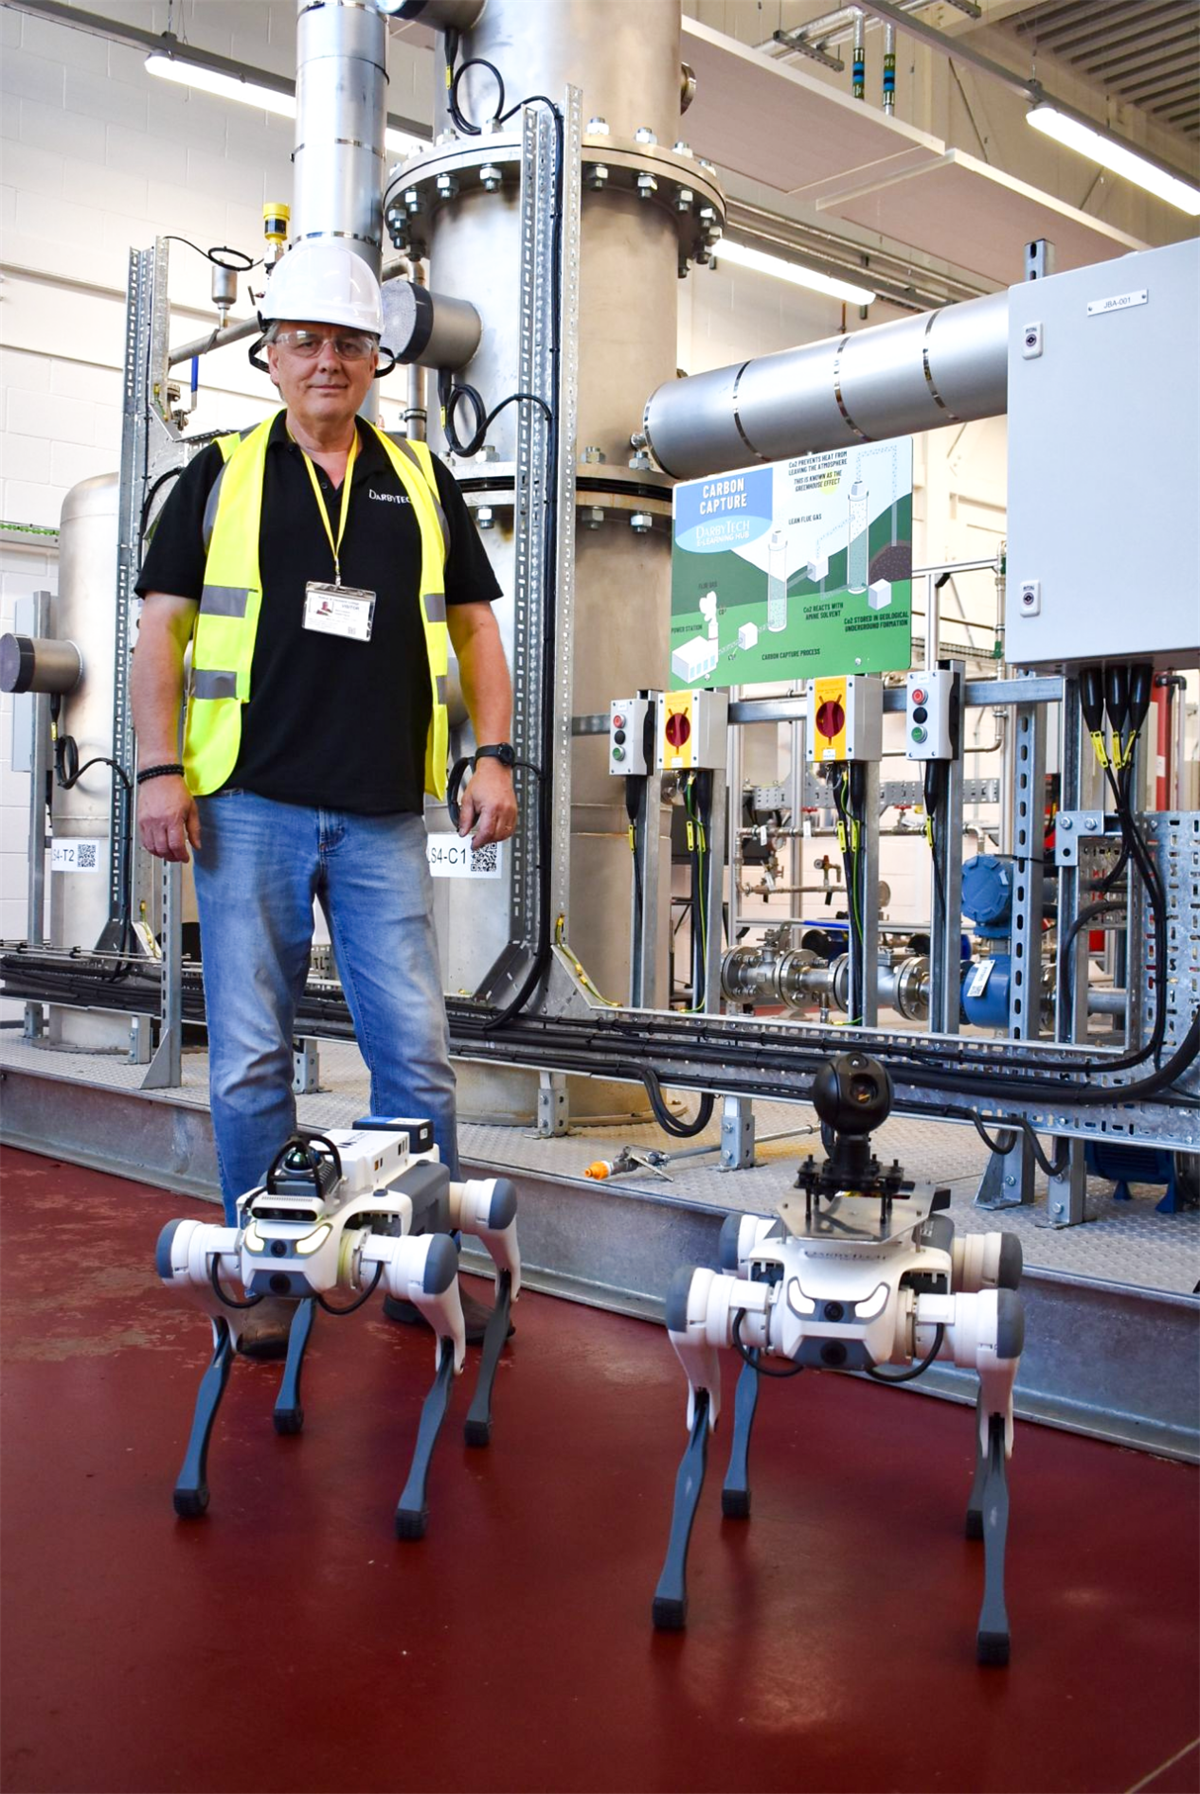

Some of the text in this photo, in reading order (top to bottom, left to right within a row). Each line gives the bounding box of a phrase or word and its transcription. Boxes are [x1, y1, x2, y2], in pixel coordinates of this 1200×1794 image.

[1103, 296, 1131, 309] JBA-001
[798, 456, 821, 466] PREVENTS
[822, 453, 834, 462] HEAT
[834, 450, 848, 459] FROM
[788, 458, 848, 476] LEAVING THE ATMOSPHERE
[794, 477, 803, 485] THIS
[809, 473, 826, 482] KNOWN
[826, 471, 833, 479] AS
[833, 469, 842, 477] THE
[702, 477, 745, 499] CARBON
[795, 477, 841, 492] GREENHOUSE EFFECT
[700, 493, 748, 515] CAPTURE
[788, 513, 822, 526] LEAN FLUE GAS
[696, 531, 750, 547] E-LEARNING HUB
[813, 603, 831, 612] REACTS
[831, 602, 844, 610] WITH
[805, 610, 841, 620] AMINE SOLVENT
[853, 615, 873, 624] STORED
[879, 611, 910, 621] GEOLOGICAL
[685, 623, 703, 632] STATION
[845, 619, 908, 633] UNDERGROUND FORMATION
[761, 648, 821, 661] CARBON CAPTURE PROCESS
[52, 848, 75, 862] S4-T2
[428, 847, 466, 865] S4-C1
